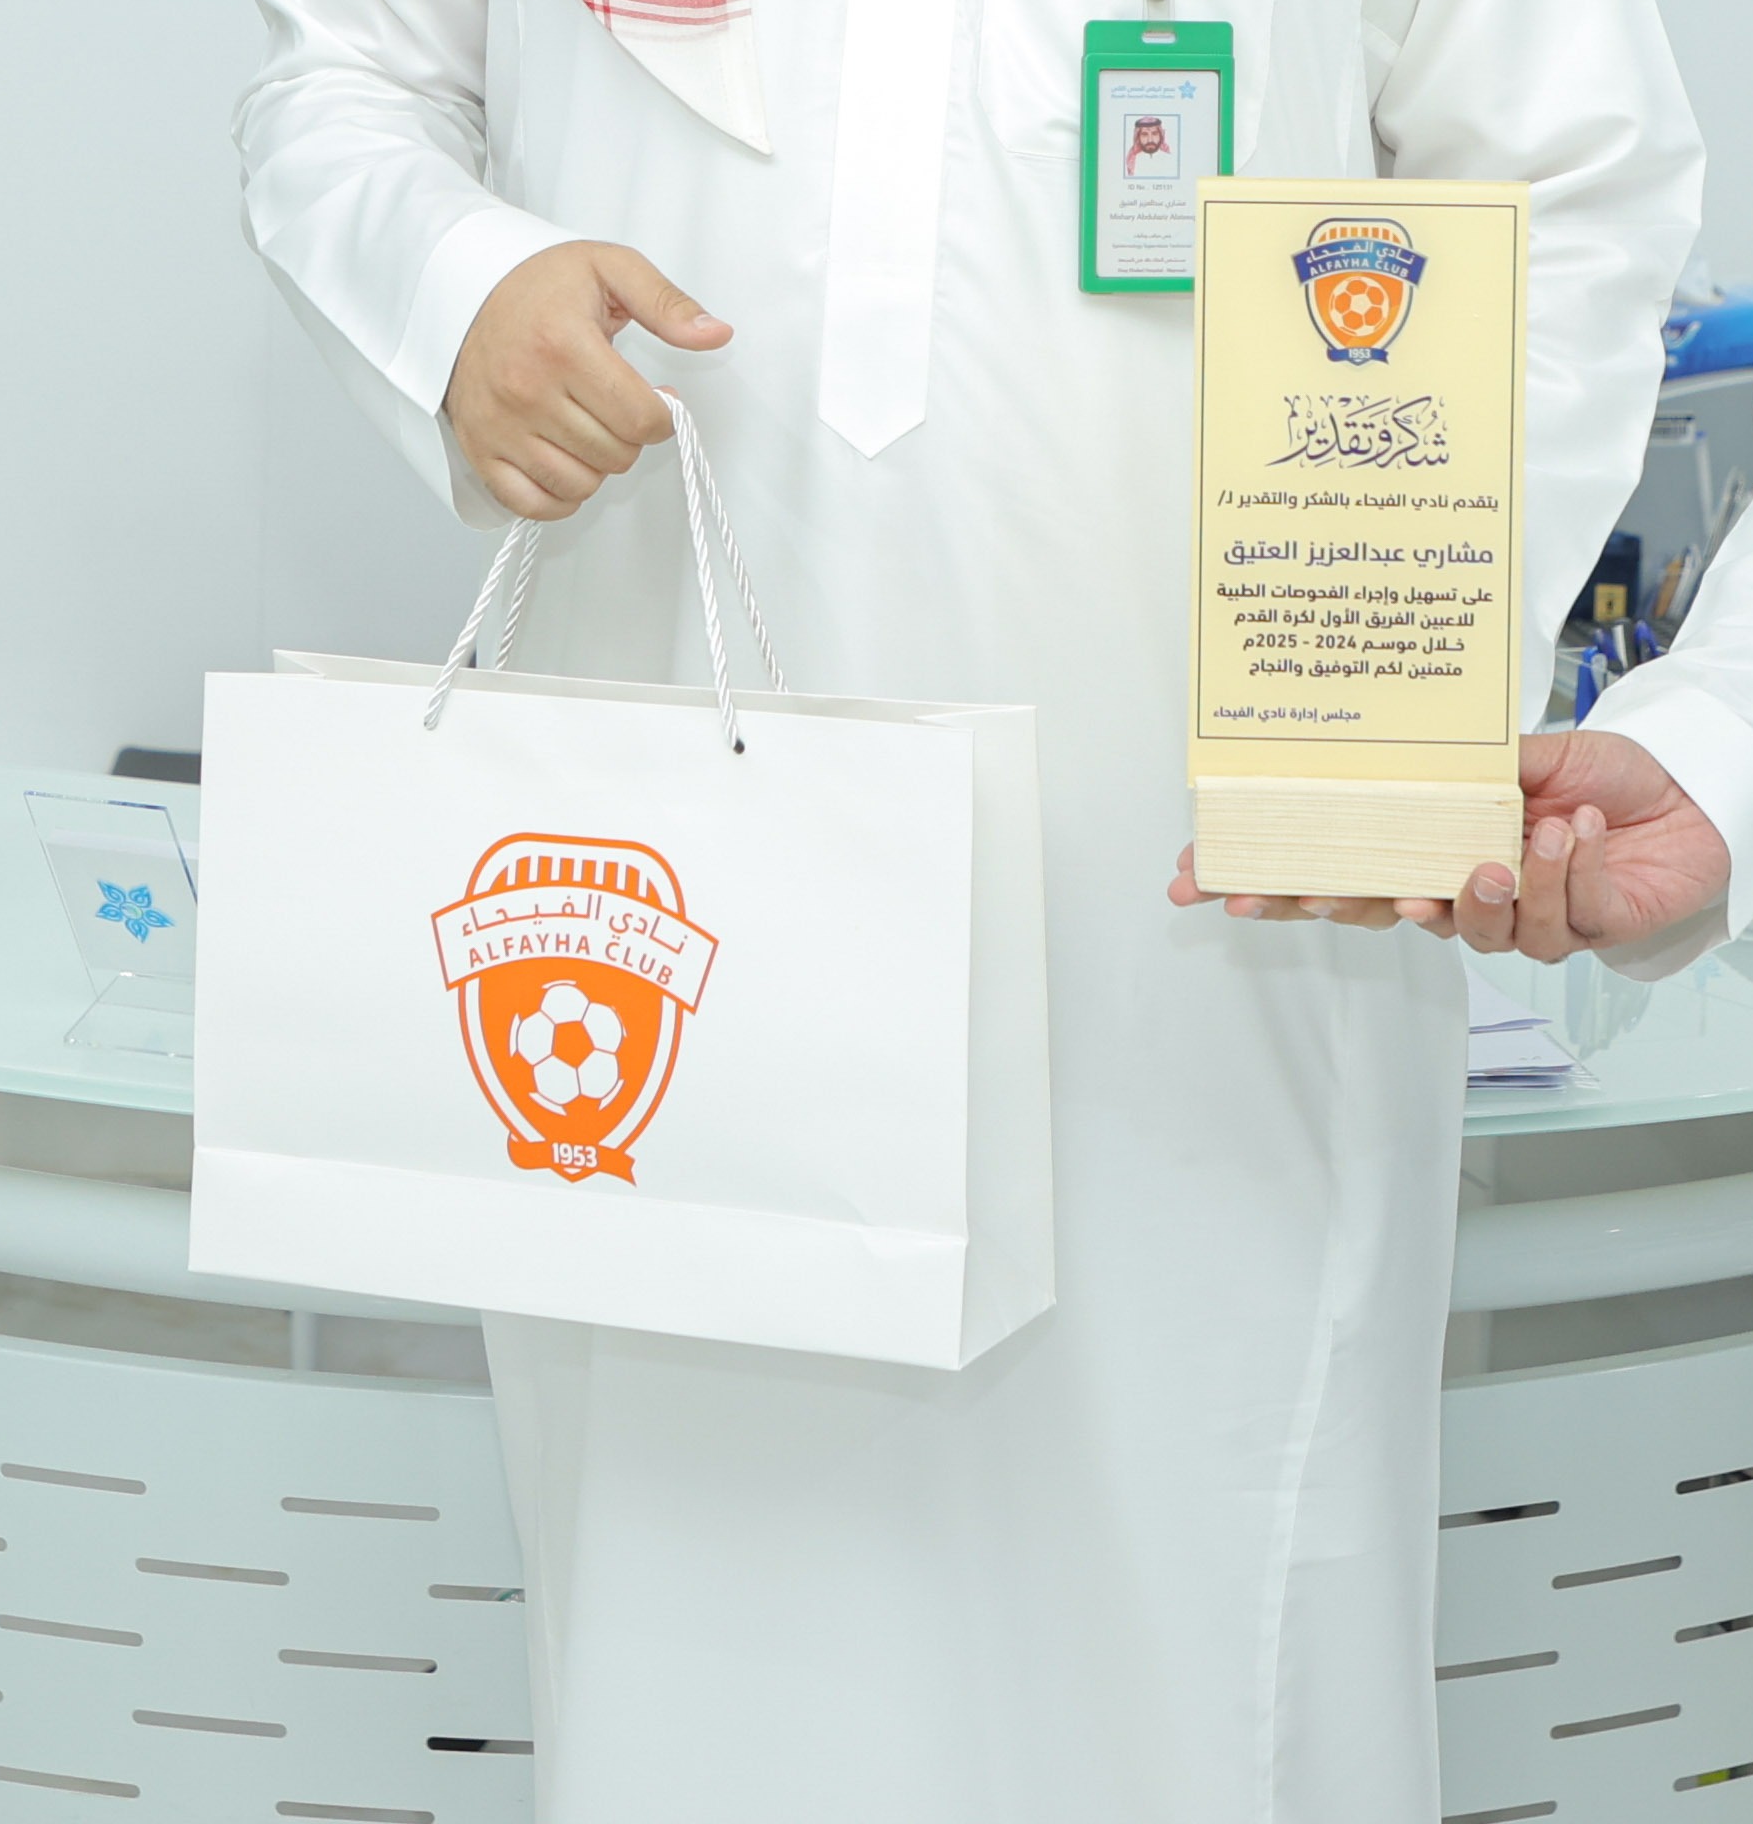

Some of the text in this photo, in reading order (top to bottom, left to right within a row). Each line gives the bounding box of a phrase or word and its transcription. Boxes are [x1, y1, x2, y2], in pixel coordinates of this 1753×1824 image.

[1310, 258, 1409, 278] ALFAYHA CLUB
[1348, 348, 1371, 359] 1953
[1236, 491, 1298, 510] والتقدير
[1301, 490, 1351, 510] بالشكر
[1354, 492, 1407, 511] الفيحاء
[1410, 494, 1449, 512] نادي
[1452, 495, 1499, 513] يتقدم
[1223, 540, 1494, 570] مشاري عبدالعزيز العتيق
[1216, 582, 1494, 606] على تسهيل وإجراء الفحوصات الطبية
[1233, 607, 1475, 631] للاعبين الفريق الأول لكرة القدم
[1314, 633, 1357, 650] 2024
[1248, 657, 1463, 680] متمنين لكم التوفيق والنجاح
[1212, 705, 1362, 724] مجلس إدارة نادي الفيحاء
[461, 893, 689, 955] نادي الفيحاء
[468, 932, 674, 986] ALFAYHA CLUB
[551, 1142, 598, 1169] 1953
